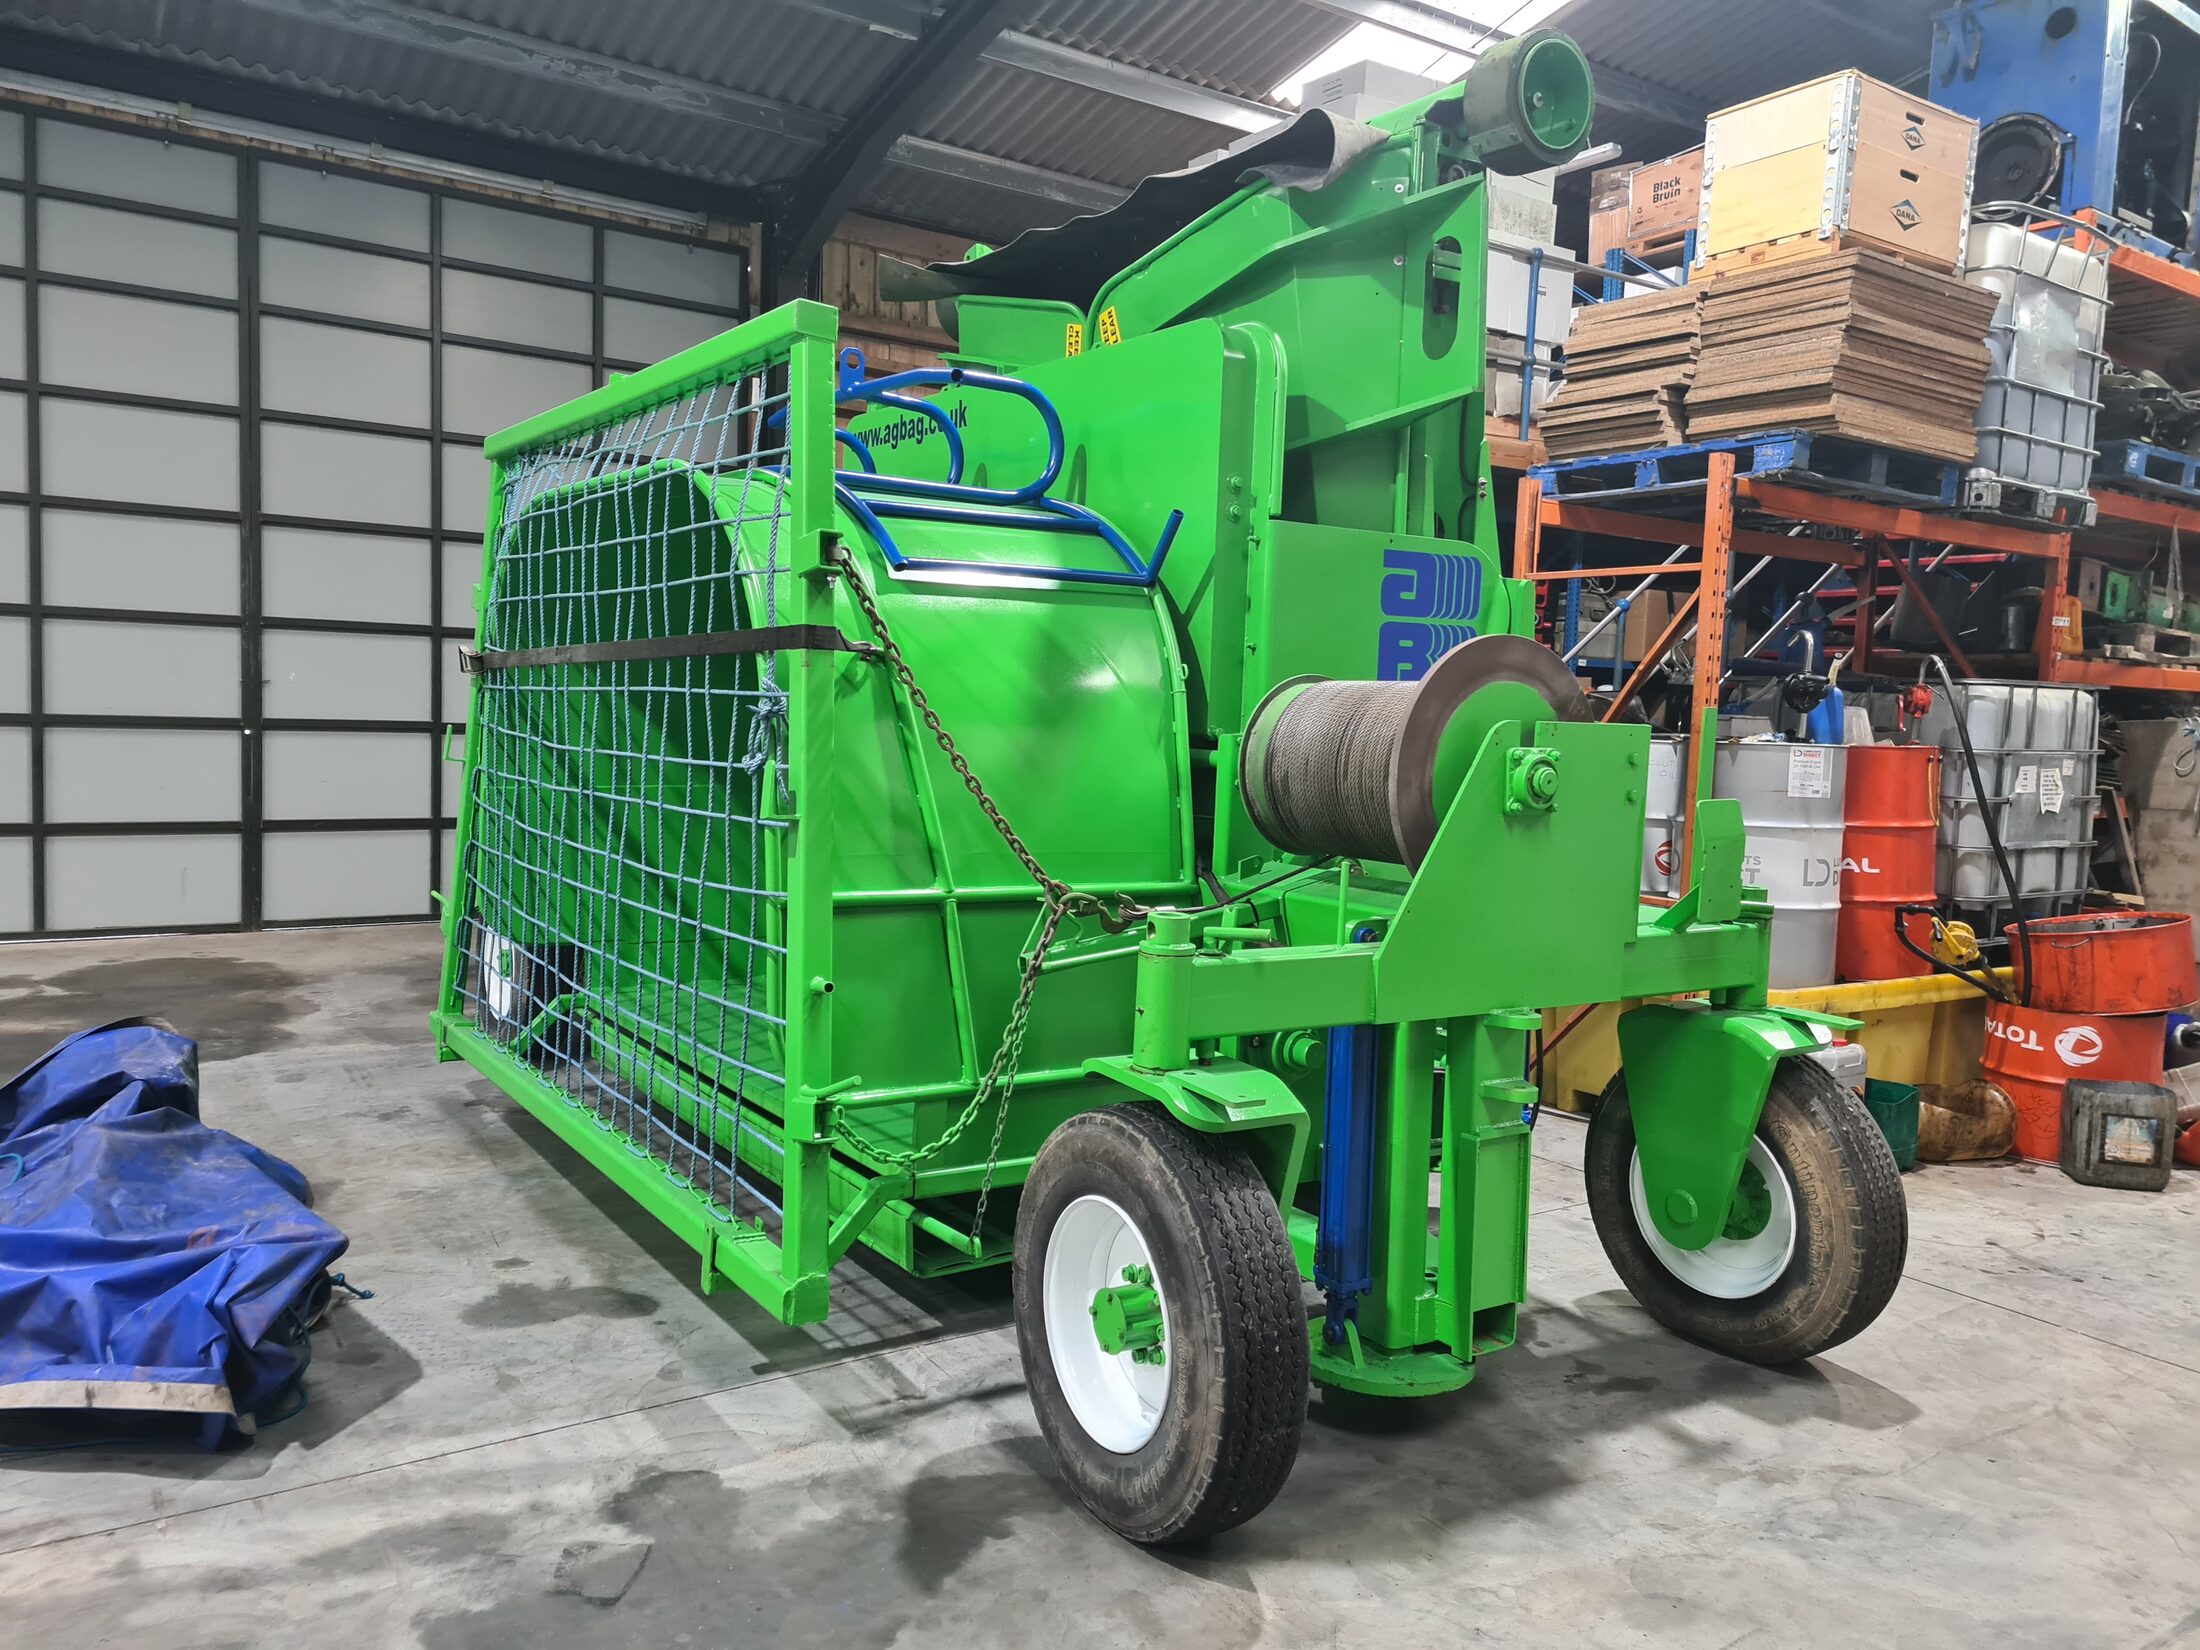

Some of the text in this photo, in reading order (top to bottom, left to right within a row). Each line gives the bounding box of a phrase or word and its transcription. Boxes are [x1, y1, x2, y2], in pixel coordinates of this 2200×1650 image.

[1653, 176, 1681, 193] Black
[1652, 188, 1681, 204] Bruin
[1896, 208, 1916, 222] DANA
[854, 399, 967, 450] ww.agbag.cuk
[1985, 1016, 2044, 1052] TOTA
